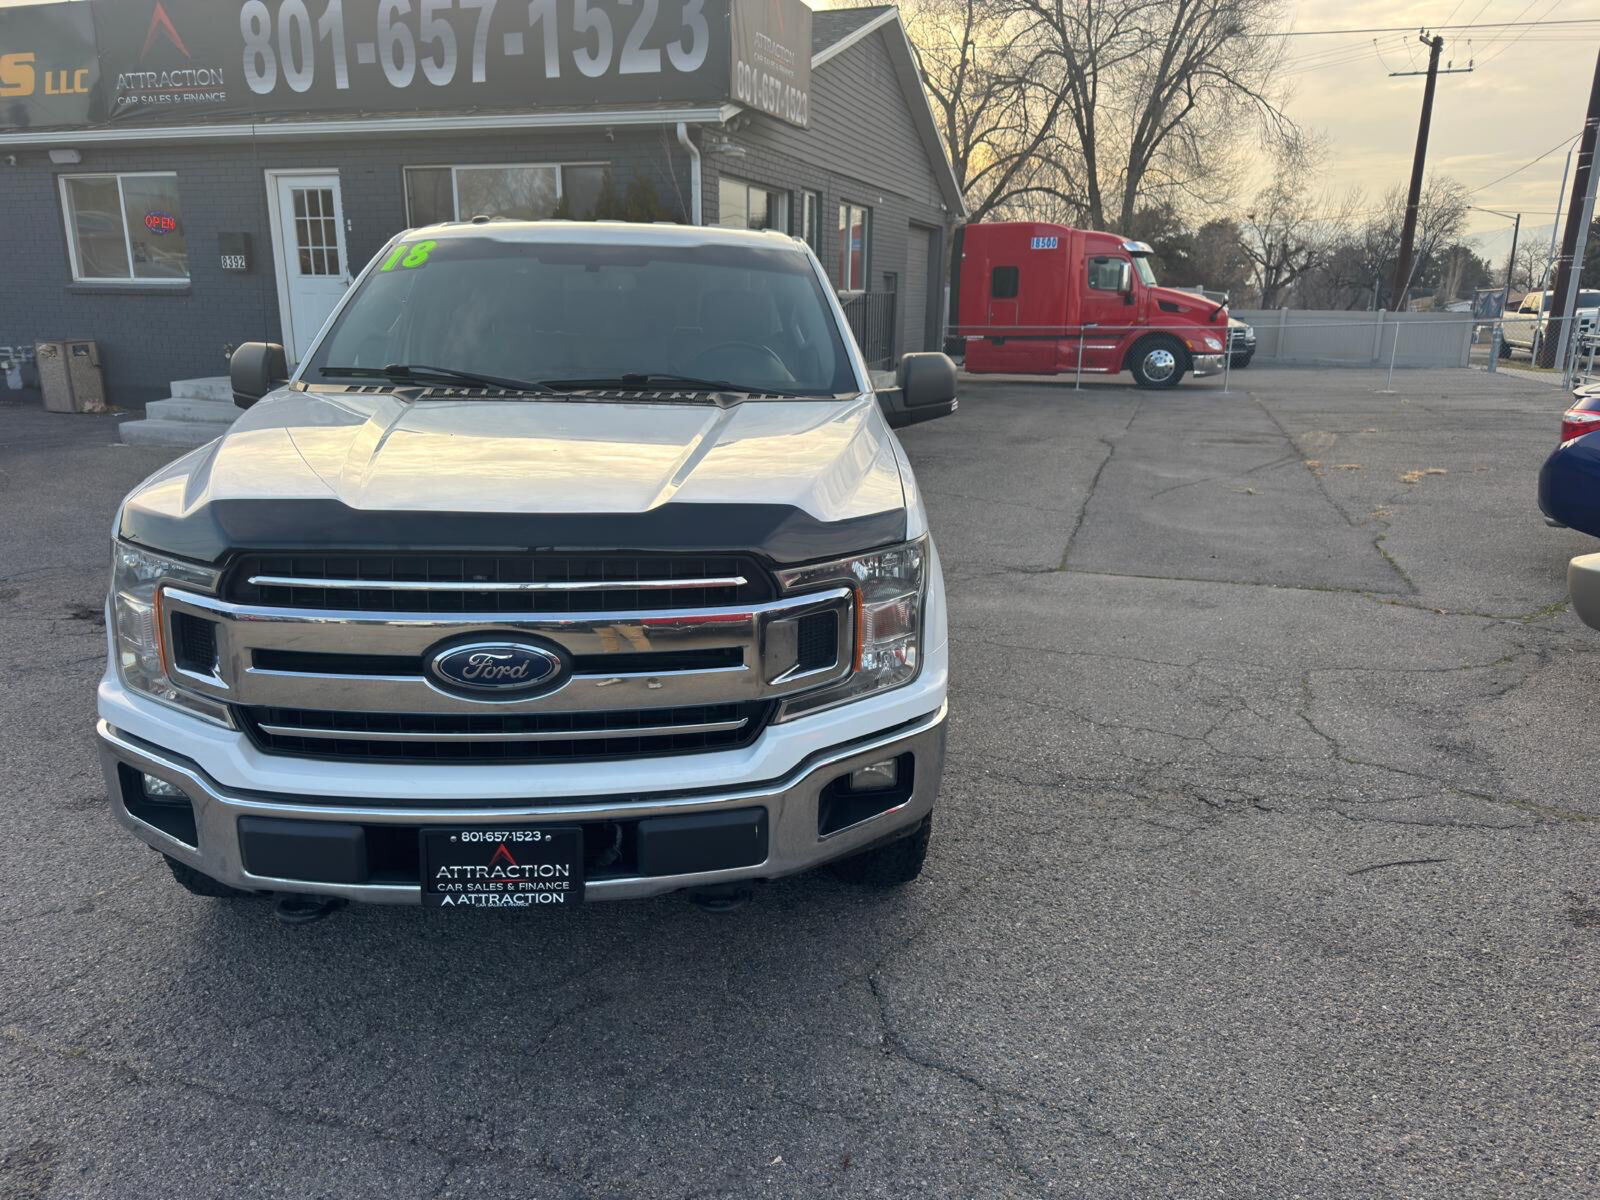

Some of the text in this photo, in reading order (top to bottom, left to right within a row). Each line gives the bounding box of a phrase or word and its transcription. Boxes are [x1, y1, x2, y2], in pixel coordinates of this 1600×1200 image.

[240, 0, 710, 94] 801-657-1523
[0, 52, 89, 97] S LLC
[116, 68, 224, 90] ATTRACTION
[117, 96, 138, 105] CAR
[141, 94, 172, 104] SALES
[183, 92, 226, 103] FINANCE
[737, 60, 808, 126] 801-657-1523
[145, 215, 176, 230] OPEN
[222, 256, 246, 268] 8392
[380, 240, 437, 272] 18
[462, 653, 530, 679] Ford
[461, 831, 542, 842] 801-657-1523
[436, 864, 570, 879] ATTRACTION
[437, 882, 570, 891] CAR SALES & FINANCE
[457, 893, 564, 905] ATTRACTION
